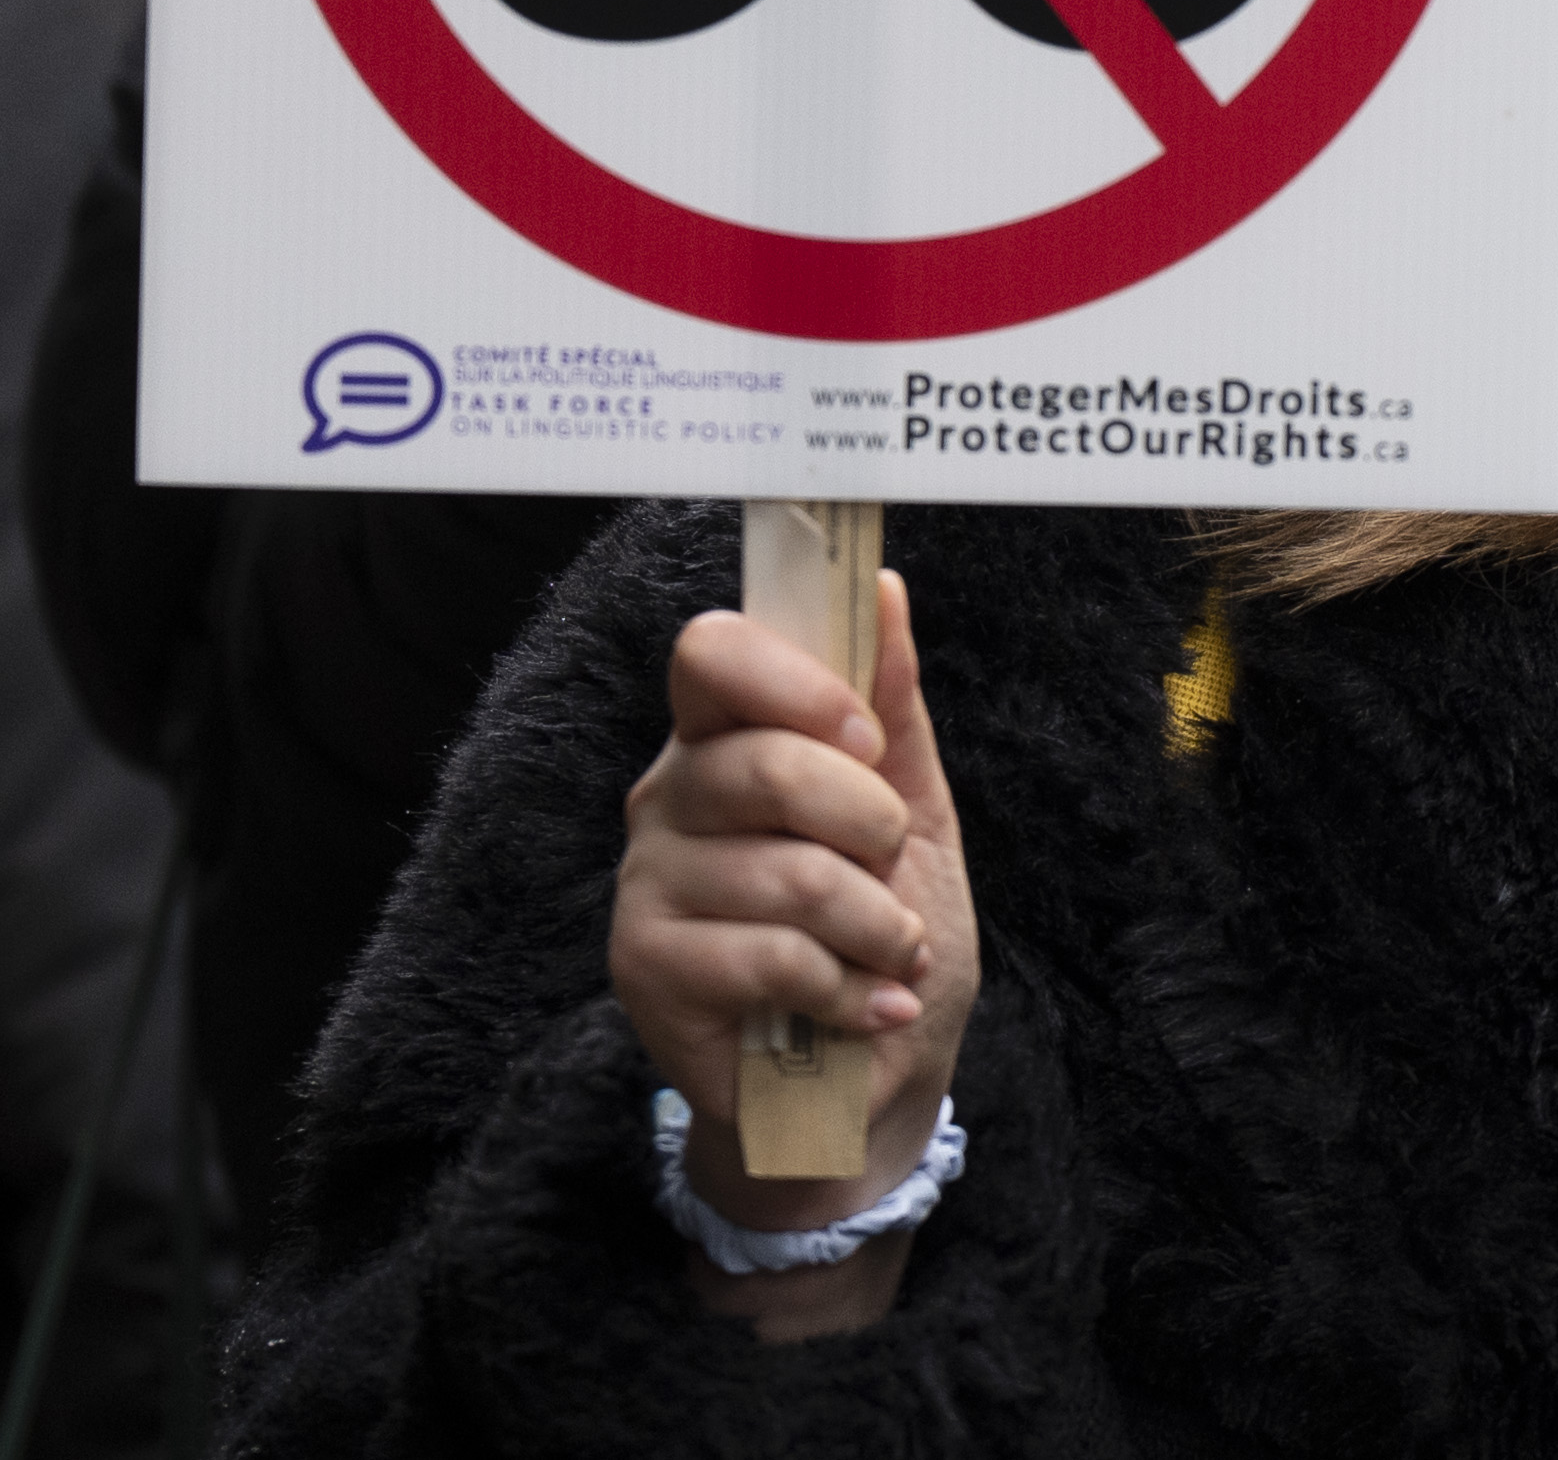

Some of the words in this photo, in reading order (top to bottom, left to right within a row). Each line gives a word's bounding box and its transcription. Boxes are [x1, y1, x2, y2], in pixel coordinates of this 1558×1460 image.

[452, 343, 550, 365] COMITÉ
[559, 344, 659, 368] SPÉCIAL
[454, 365, 493, 385] SUR
[499, 367, 524, 385] LA
[529, 367, 635, 388] POLITIQUE
[641, 371, 785, 392] LINGUISTIQUE
[451, 392, 530, 413] TASK
[550, 394, 654, 417] FORCE
[809, 372, 1415, 419] www.ProtegerMesDroits.ca
[451, 415, 493, 437] ON
[504, 417, 670, 442] LINGUISTIC
[680, 420, 785, 445] POLICY
[804, 415, 1411, 466] www.ProtectOurRights.ca
